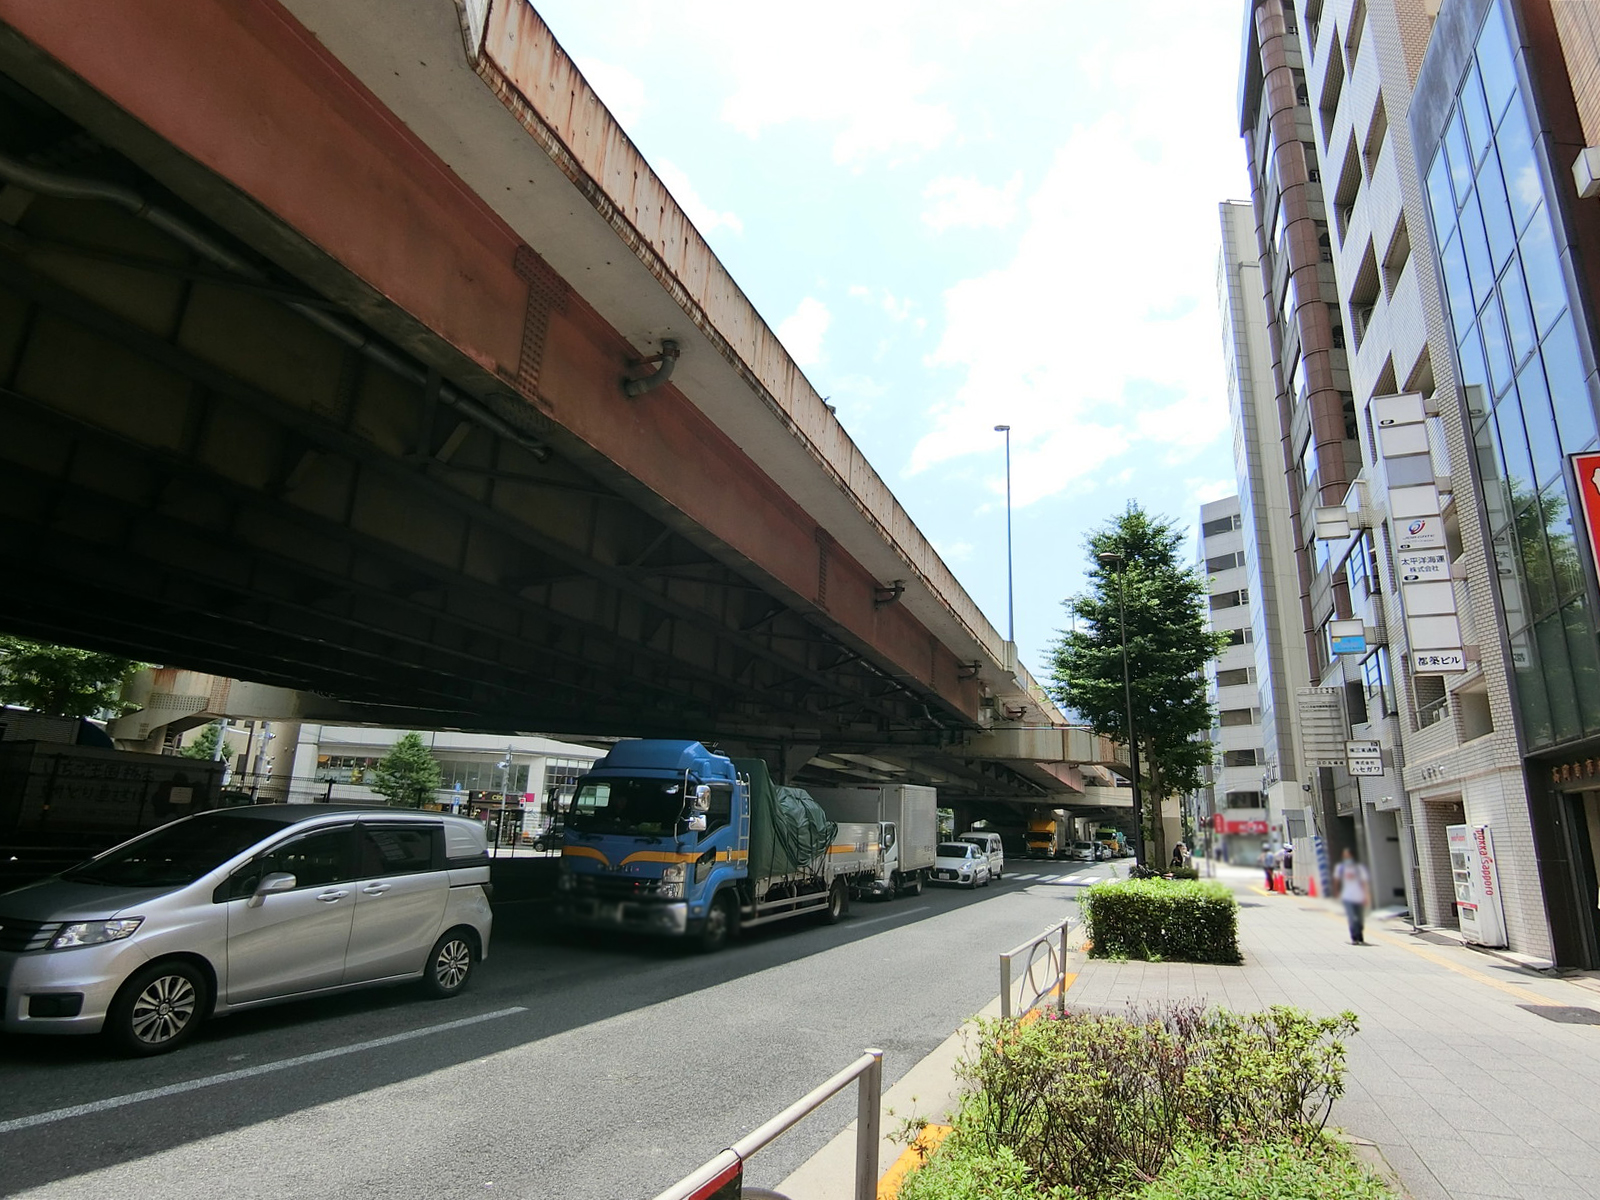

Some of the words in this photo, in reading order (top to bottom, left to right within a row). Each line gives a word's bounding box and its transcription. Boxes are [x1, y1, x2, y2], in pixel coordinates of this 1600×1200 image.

[1401, 555, 1445, 566] 太平洋海運
[1410, 565, 1439, 573] 株式会社
[1418, 656, 1461, 666] 都築ビル
